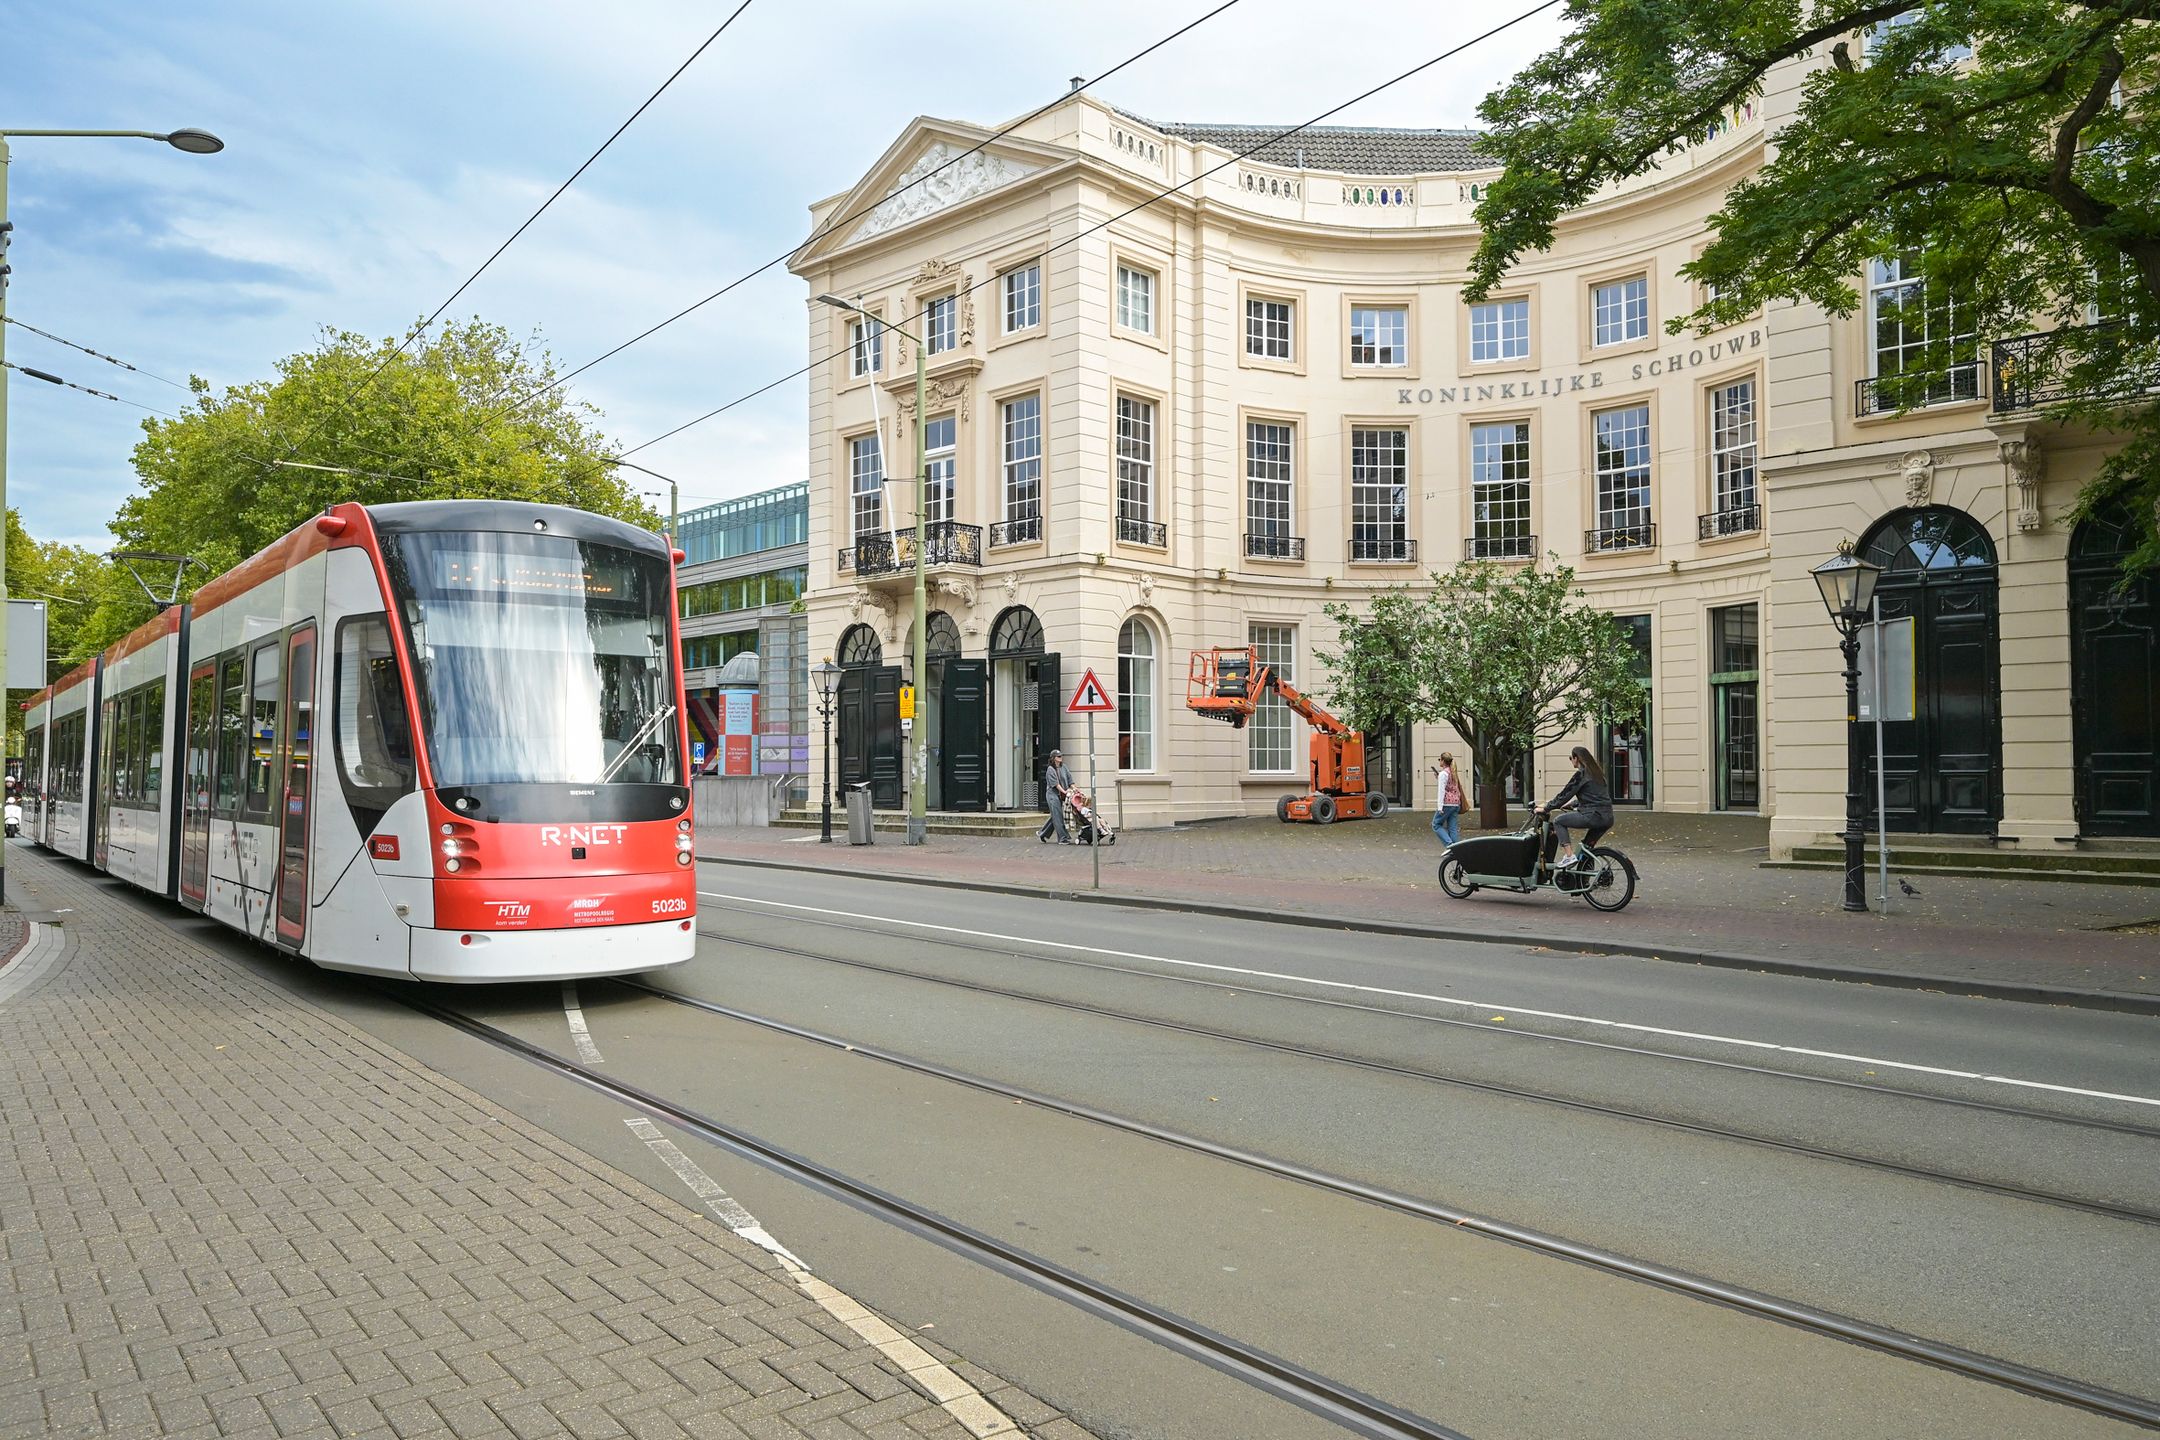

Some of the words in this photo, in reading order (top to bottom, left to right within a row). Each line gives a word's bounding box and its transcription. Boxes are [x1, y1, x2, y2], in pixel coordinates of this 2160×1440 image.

[1398, 371, 1604, 404] KONINKLIJKE
[1631, 326, 1769, 380] SCHOUWB
[378, 843, 394, 853] 5023b
[573, 899, 599, 908] MRDH
[651, 897, 687, 914] 5023b
[497, 904, 531, 917] HTM
